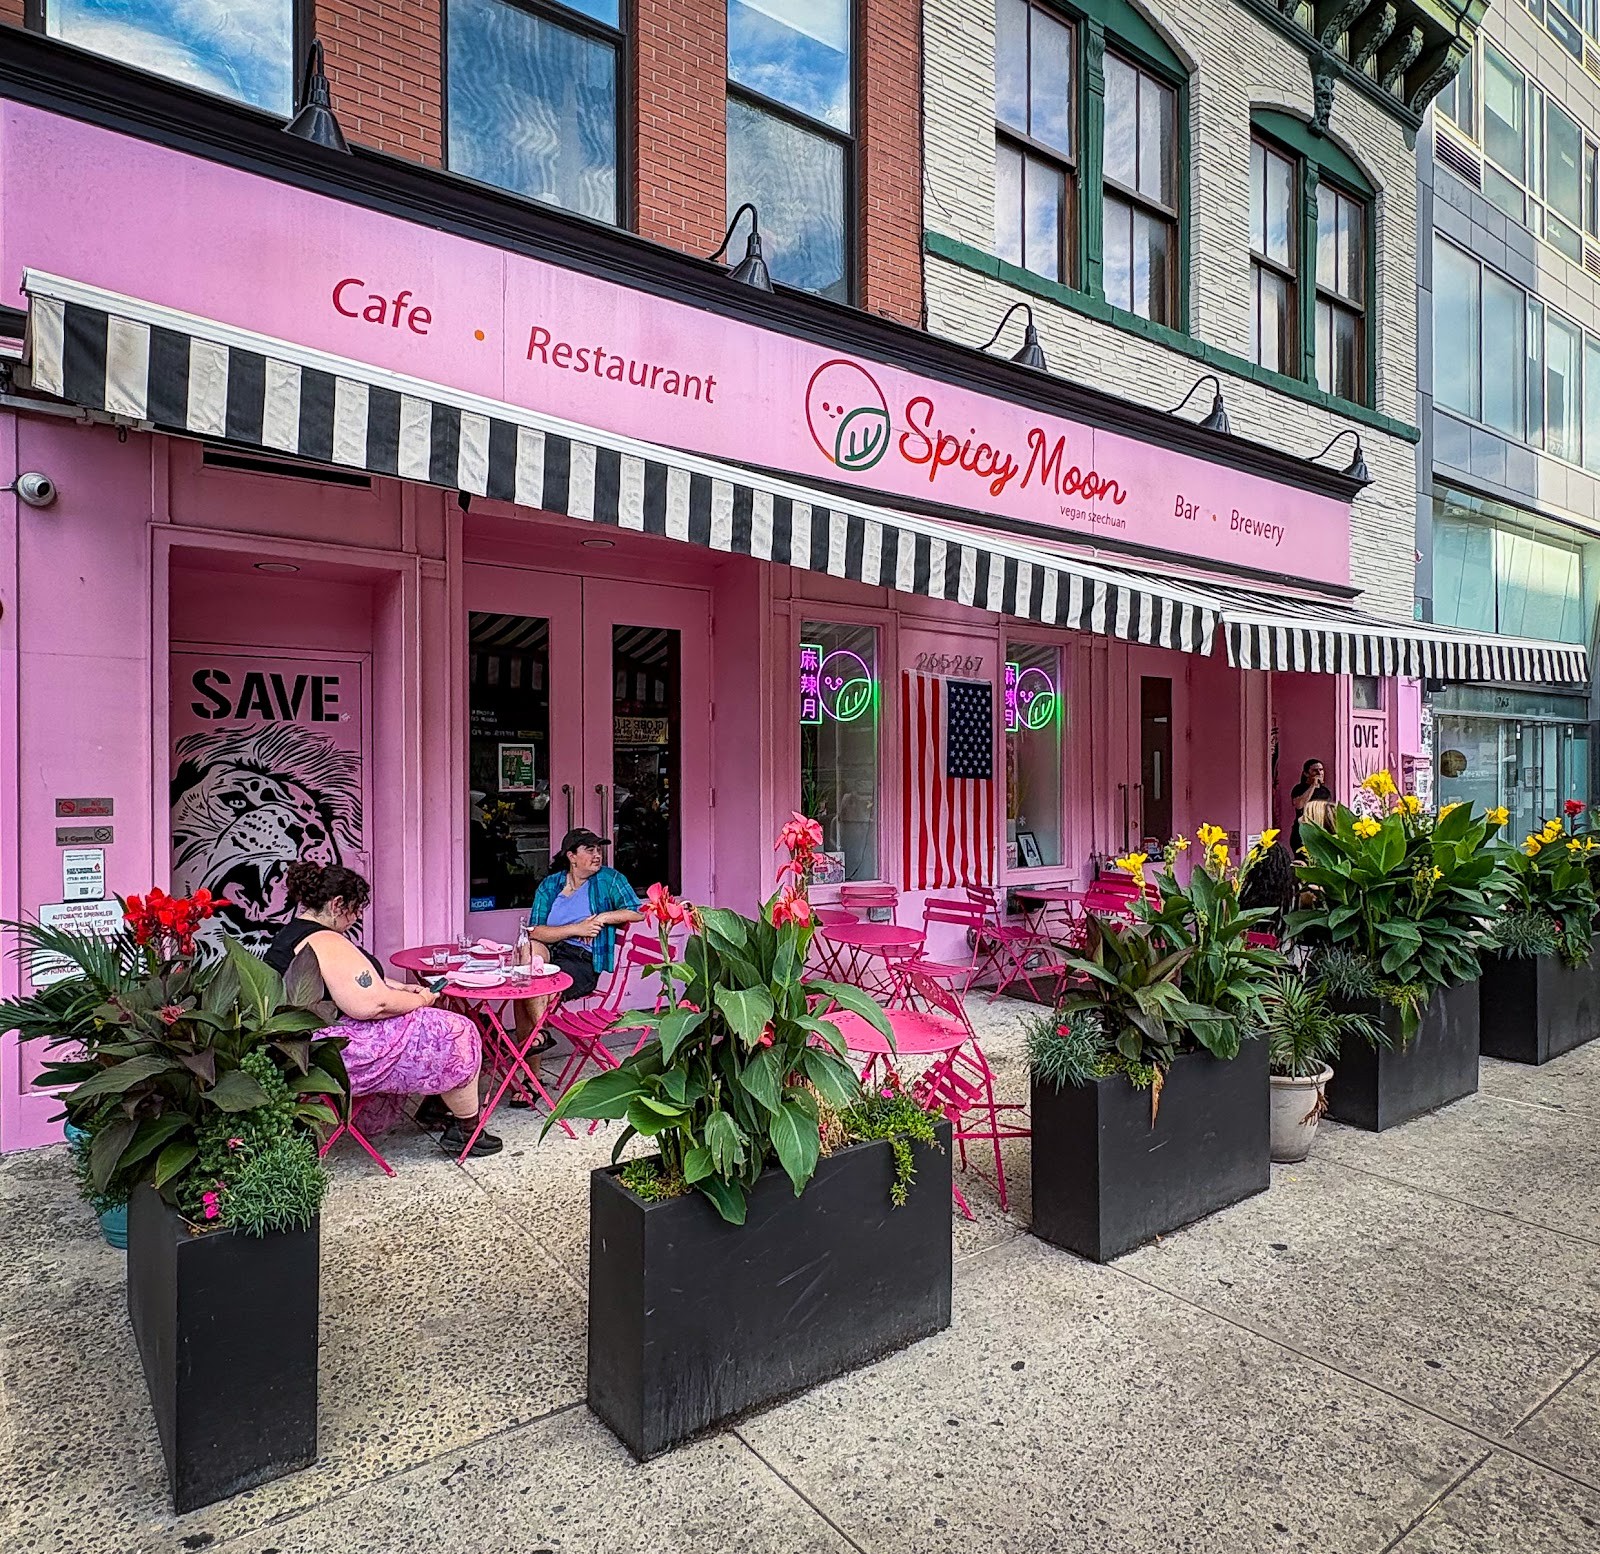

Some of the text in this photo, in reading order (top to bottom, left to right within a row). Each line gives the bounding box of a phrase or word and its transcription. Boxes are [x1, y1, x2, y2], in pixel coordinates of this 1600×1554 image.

[332, 278, 717, 404] Cafe Restaurant
[899, 396, 1127, 505] Spicy Moon
[1060, 505, 1127, 530] vegan szechuan
[1174, 494, 1285, 546] Bar Brewery
[191, 668, 340, 722] SAVE
[1353, 724, 1379, 748] OVE
[1025, 839, 1037, 858] A
